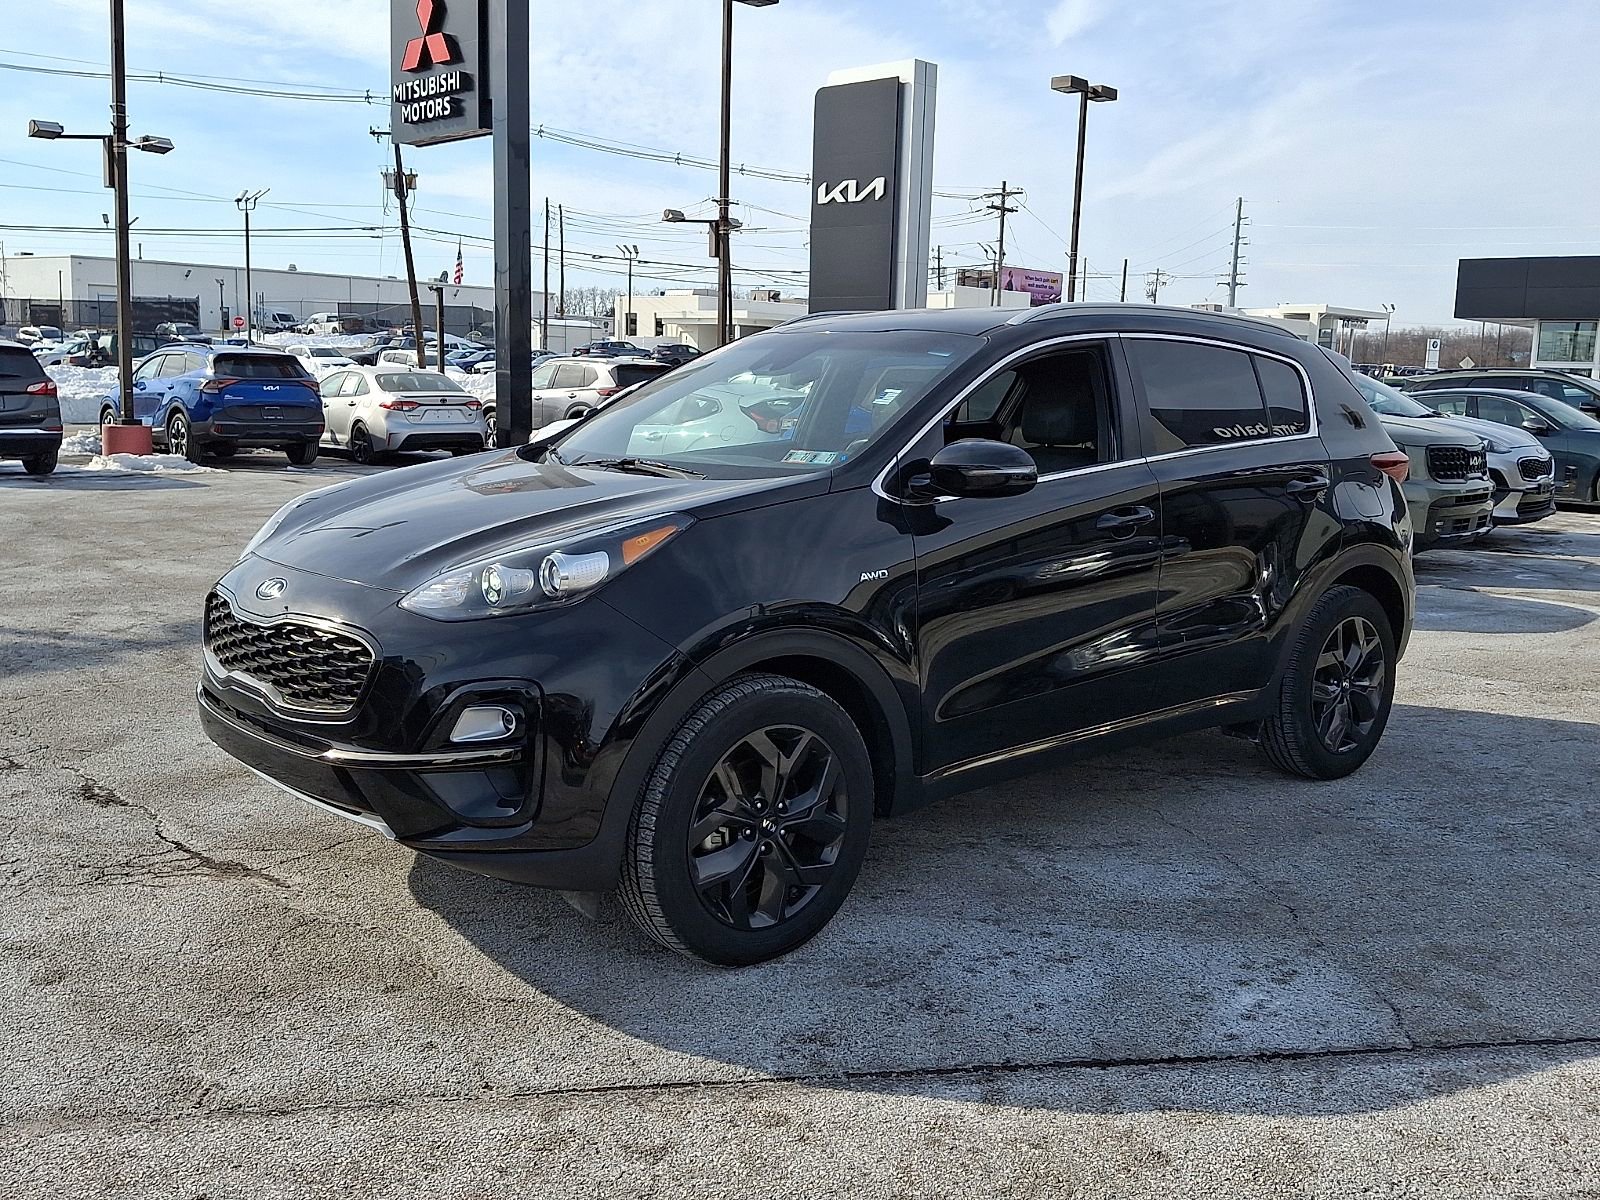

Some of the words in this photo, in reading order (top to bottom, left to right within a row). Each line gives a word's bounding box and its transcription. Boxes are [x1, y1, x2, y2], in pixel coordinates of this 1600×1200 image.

[393, 70, 460, 102] MITSUBISHI
[401, 96, 451, 123] MOTORS
[817, 176, 886, 205] KIA
[860, 569, 889, 582] AWD
[762, 818, 777, 833] KIA
